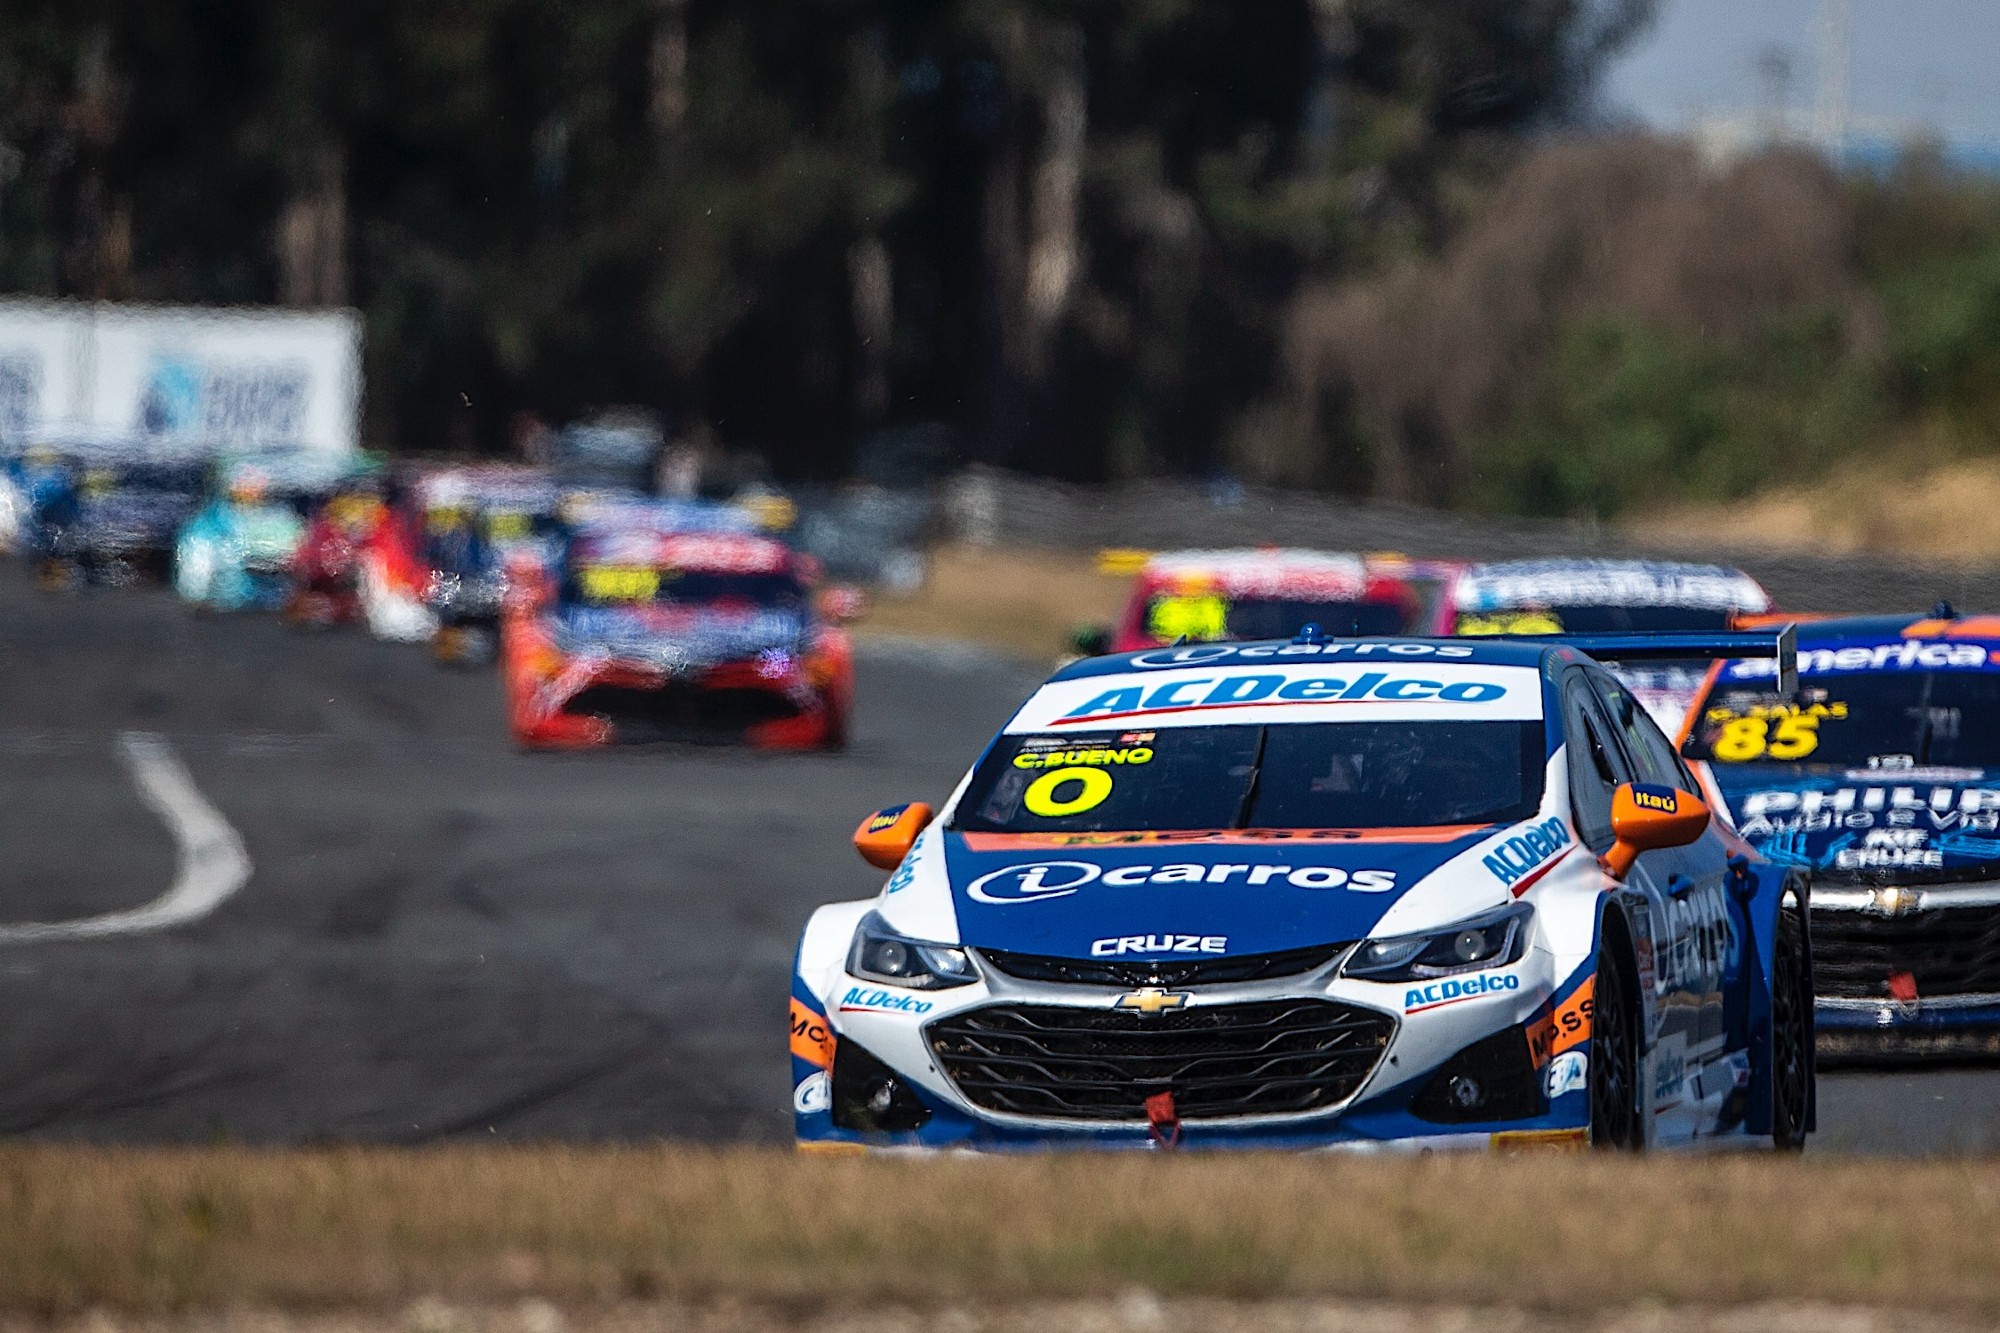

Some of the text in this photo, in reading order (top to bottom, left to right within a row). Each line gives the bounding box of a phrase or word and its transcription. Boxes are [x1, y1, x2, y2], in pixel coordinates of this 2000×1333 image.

[1062, 672, 1507, 718] ACDelco
[1711, 714, 1819, 761] 85
[1024, 766, 1113, 817] 0
[1635, 792, 1676, 812] Itaú
[1482, 816, 1571, 886] ACDelco
[1091, 935, 1228, 957] CRUZE
[842, 987, 933, 1014] ACDelco
[1404, 974, 1519, 1008] ACDelco
